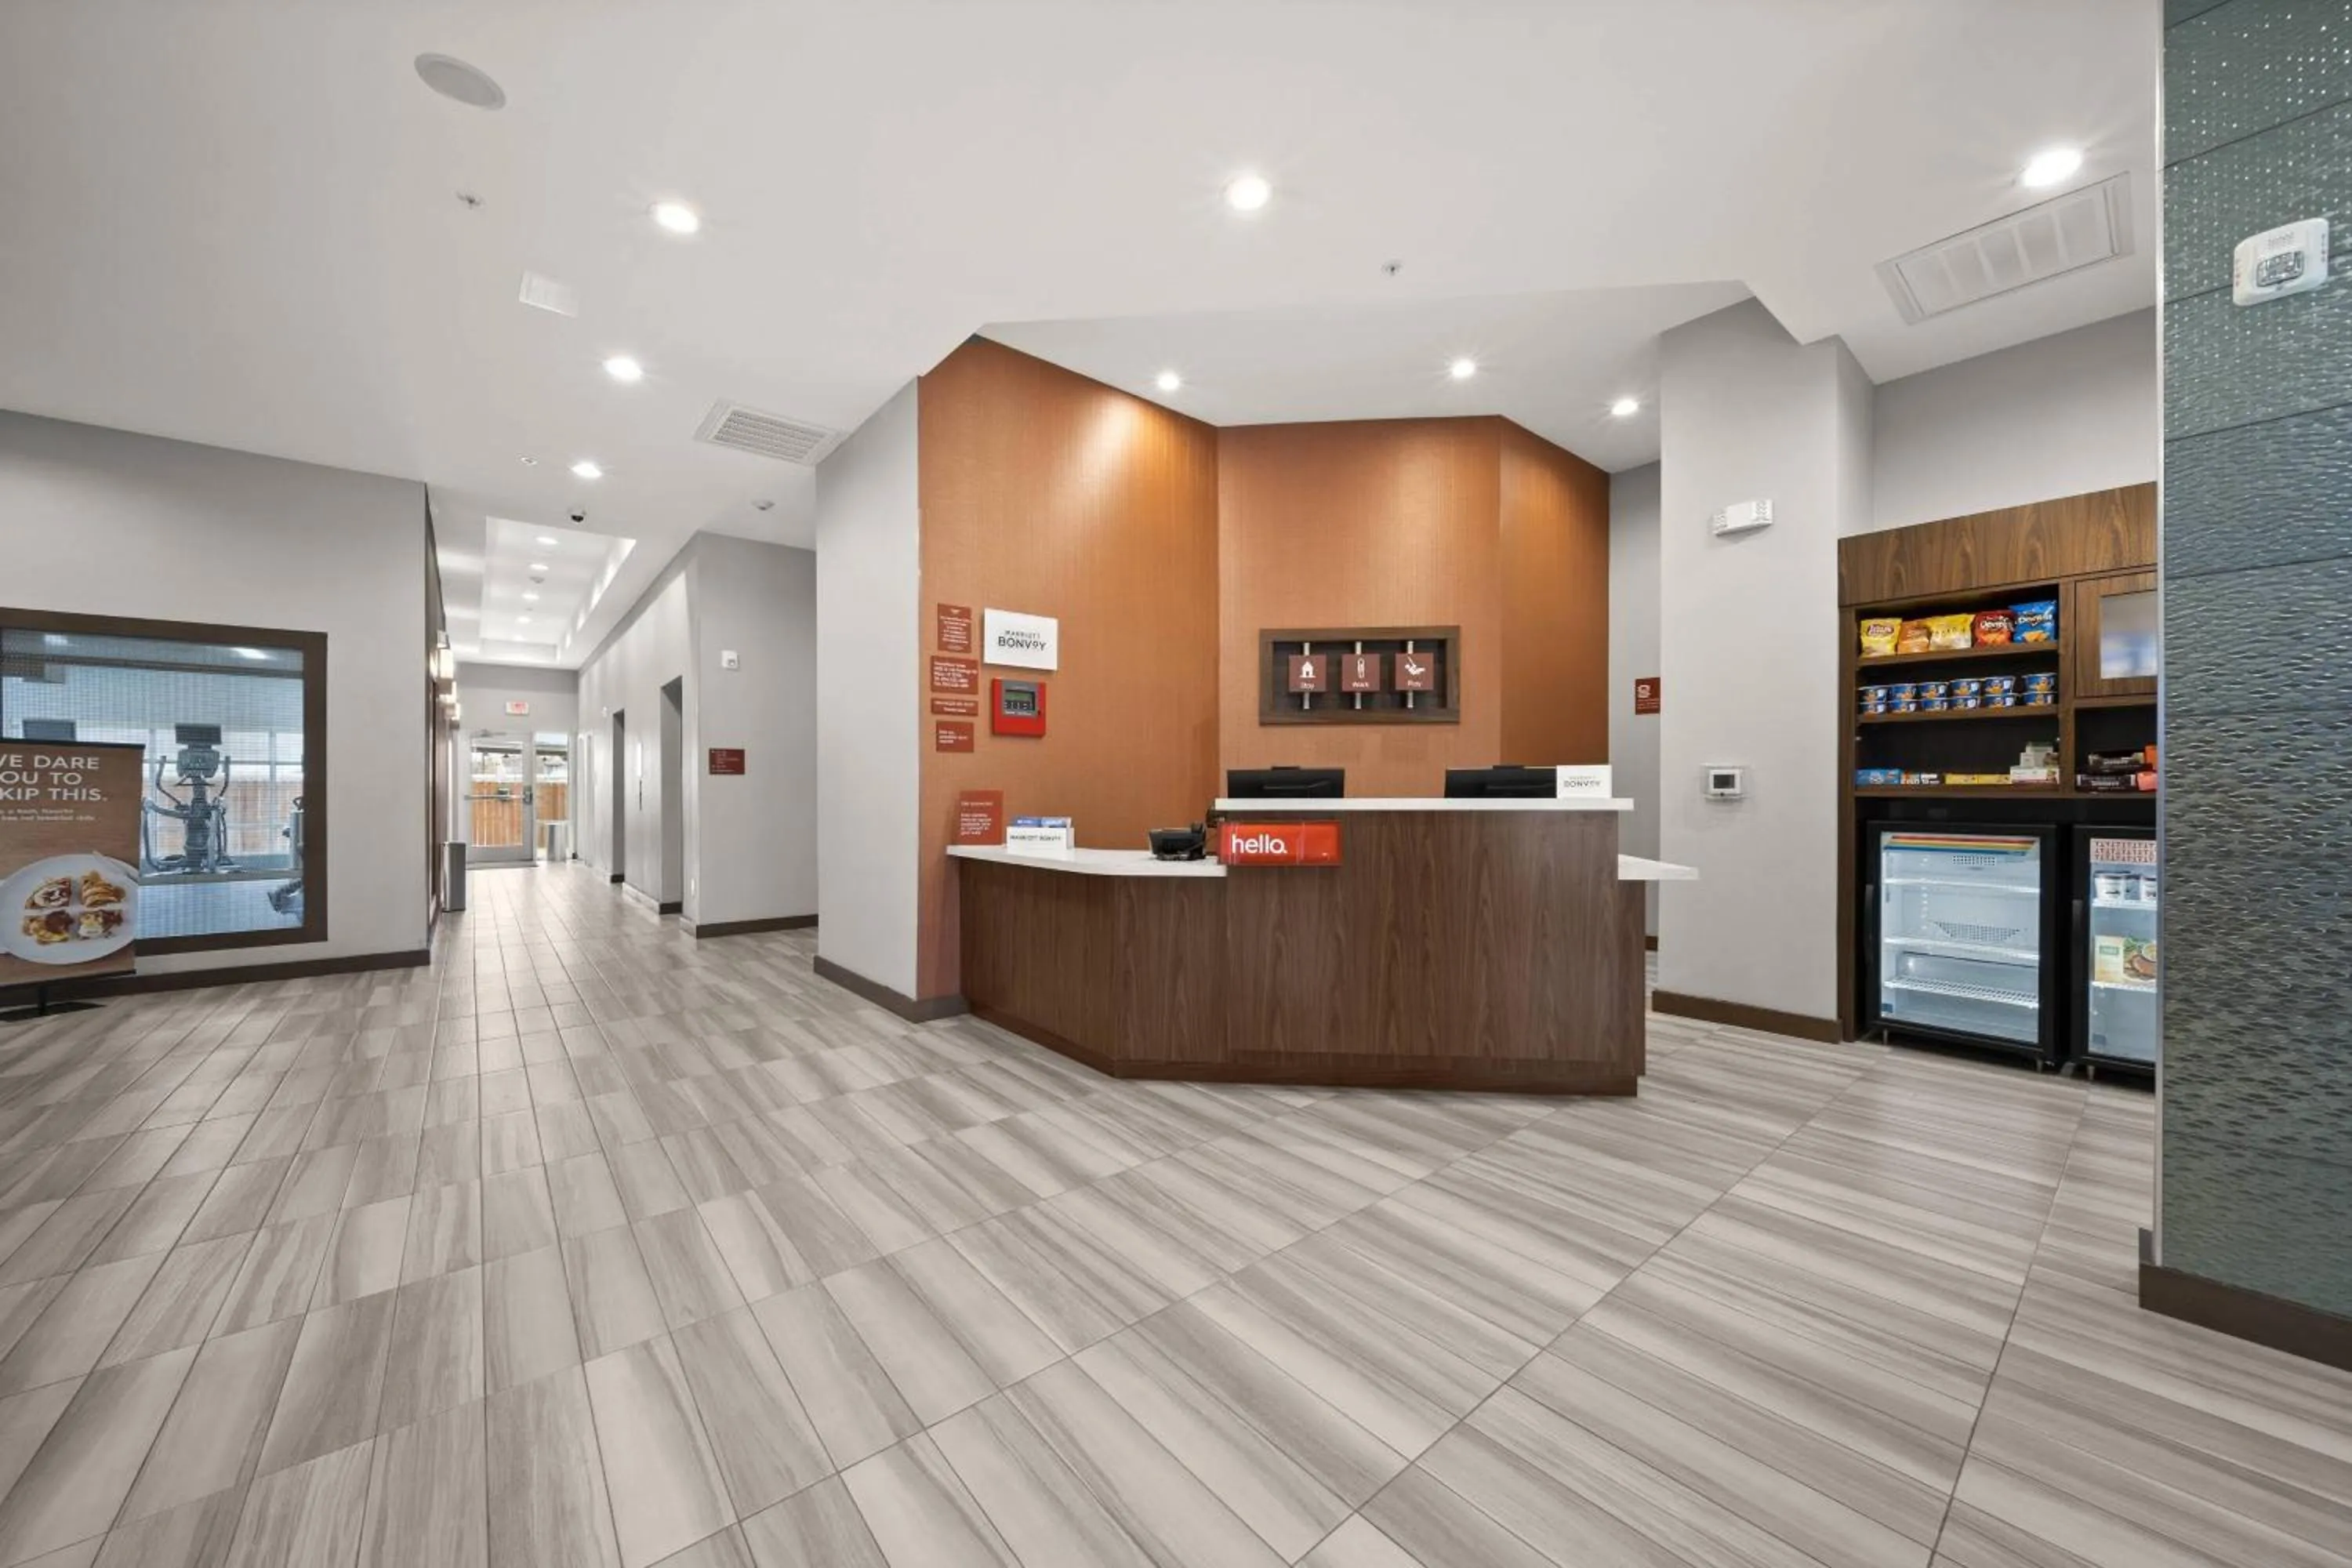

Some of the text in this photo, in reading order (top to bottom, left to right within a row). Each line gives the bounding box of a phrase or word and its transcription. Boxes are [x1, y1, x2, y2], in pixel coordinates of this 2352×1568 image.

[998, 636, 1047, 651] BONVOY
[34, 755, 100, 769] DARE
[0, 771, 82, 785] OU TO
[0, 787, 107, 801] KIP THIS.
[1232, 833, 1288, 854] hello.
